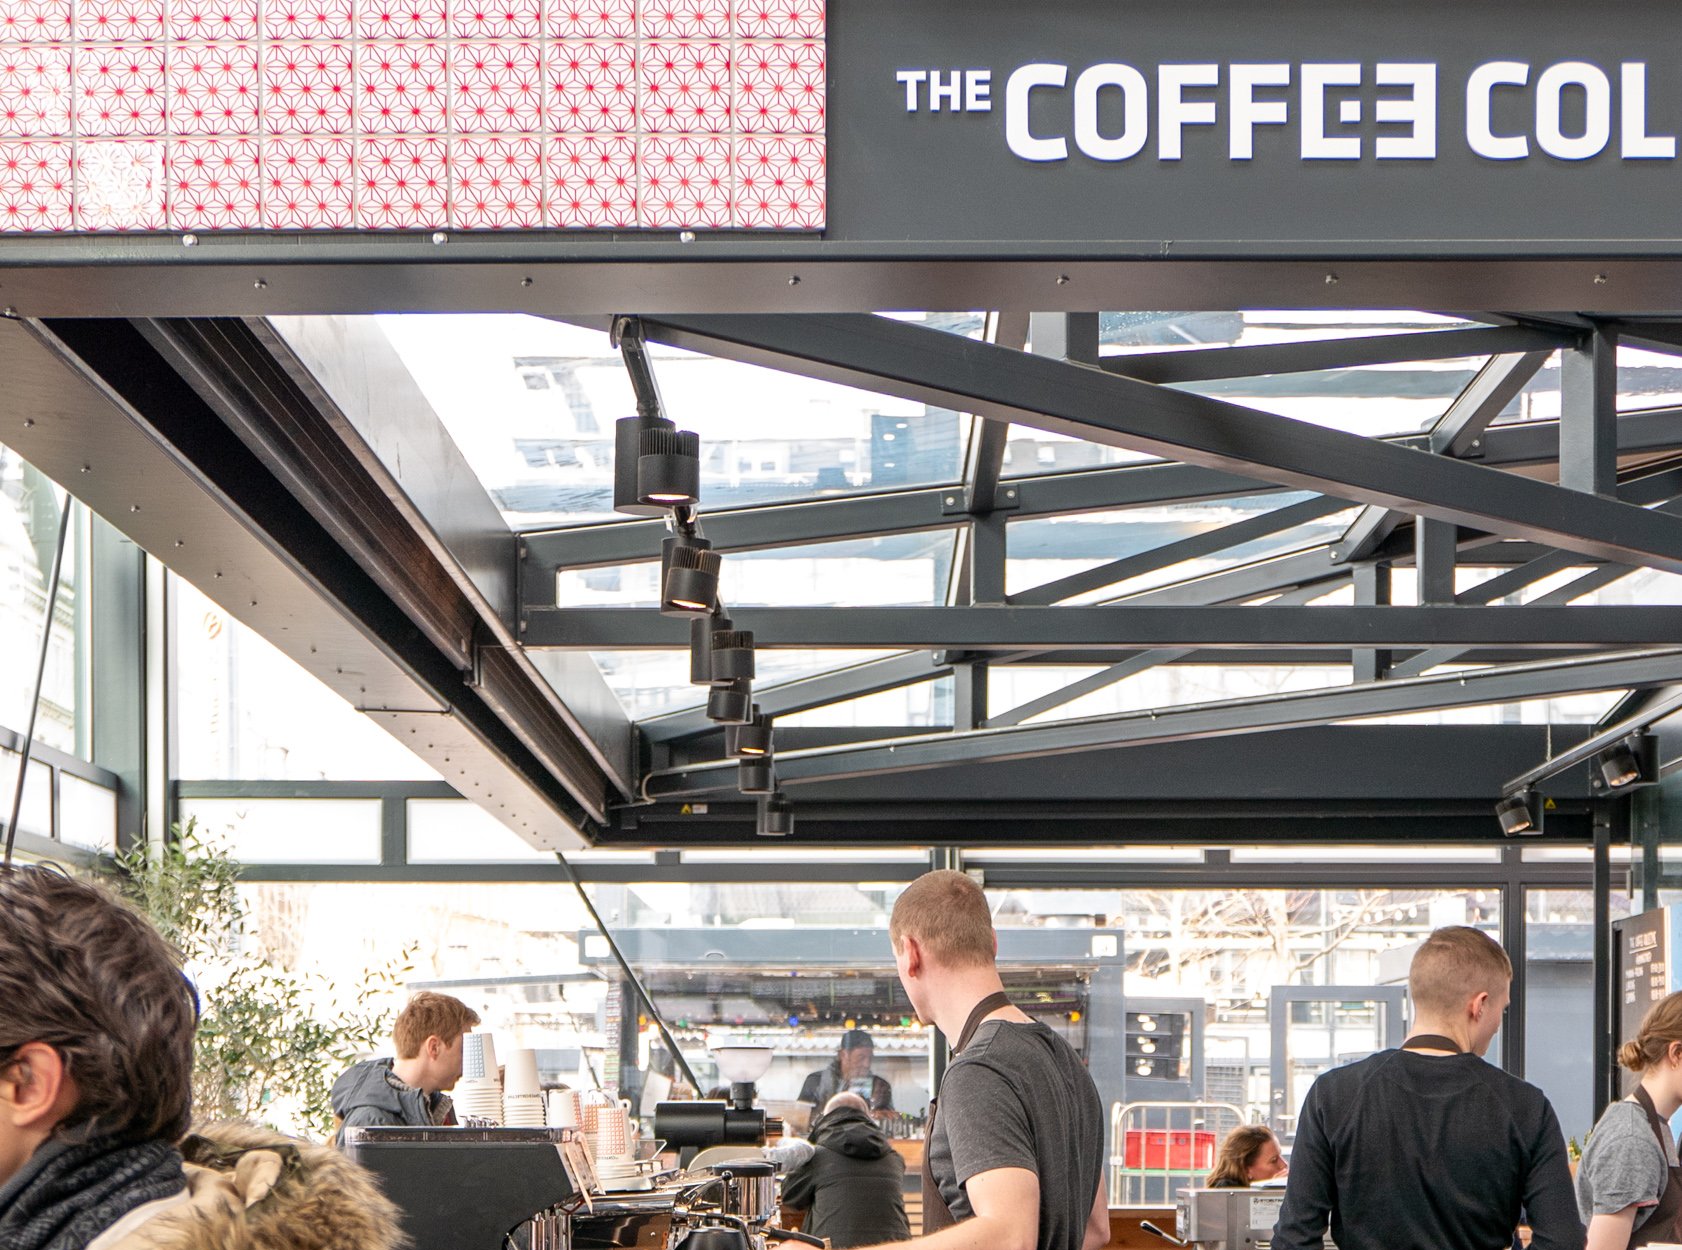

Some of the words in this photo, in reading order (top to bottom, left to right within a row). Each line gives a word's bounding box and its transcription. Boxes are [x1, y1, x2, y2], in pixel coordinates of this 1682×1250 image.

[896, 69, 992, 113] THE
[1005, 62, 1437, 161] COFFEE
[1465, 61, 1676, 161] COL
